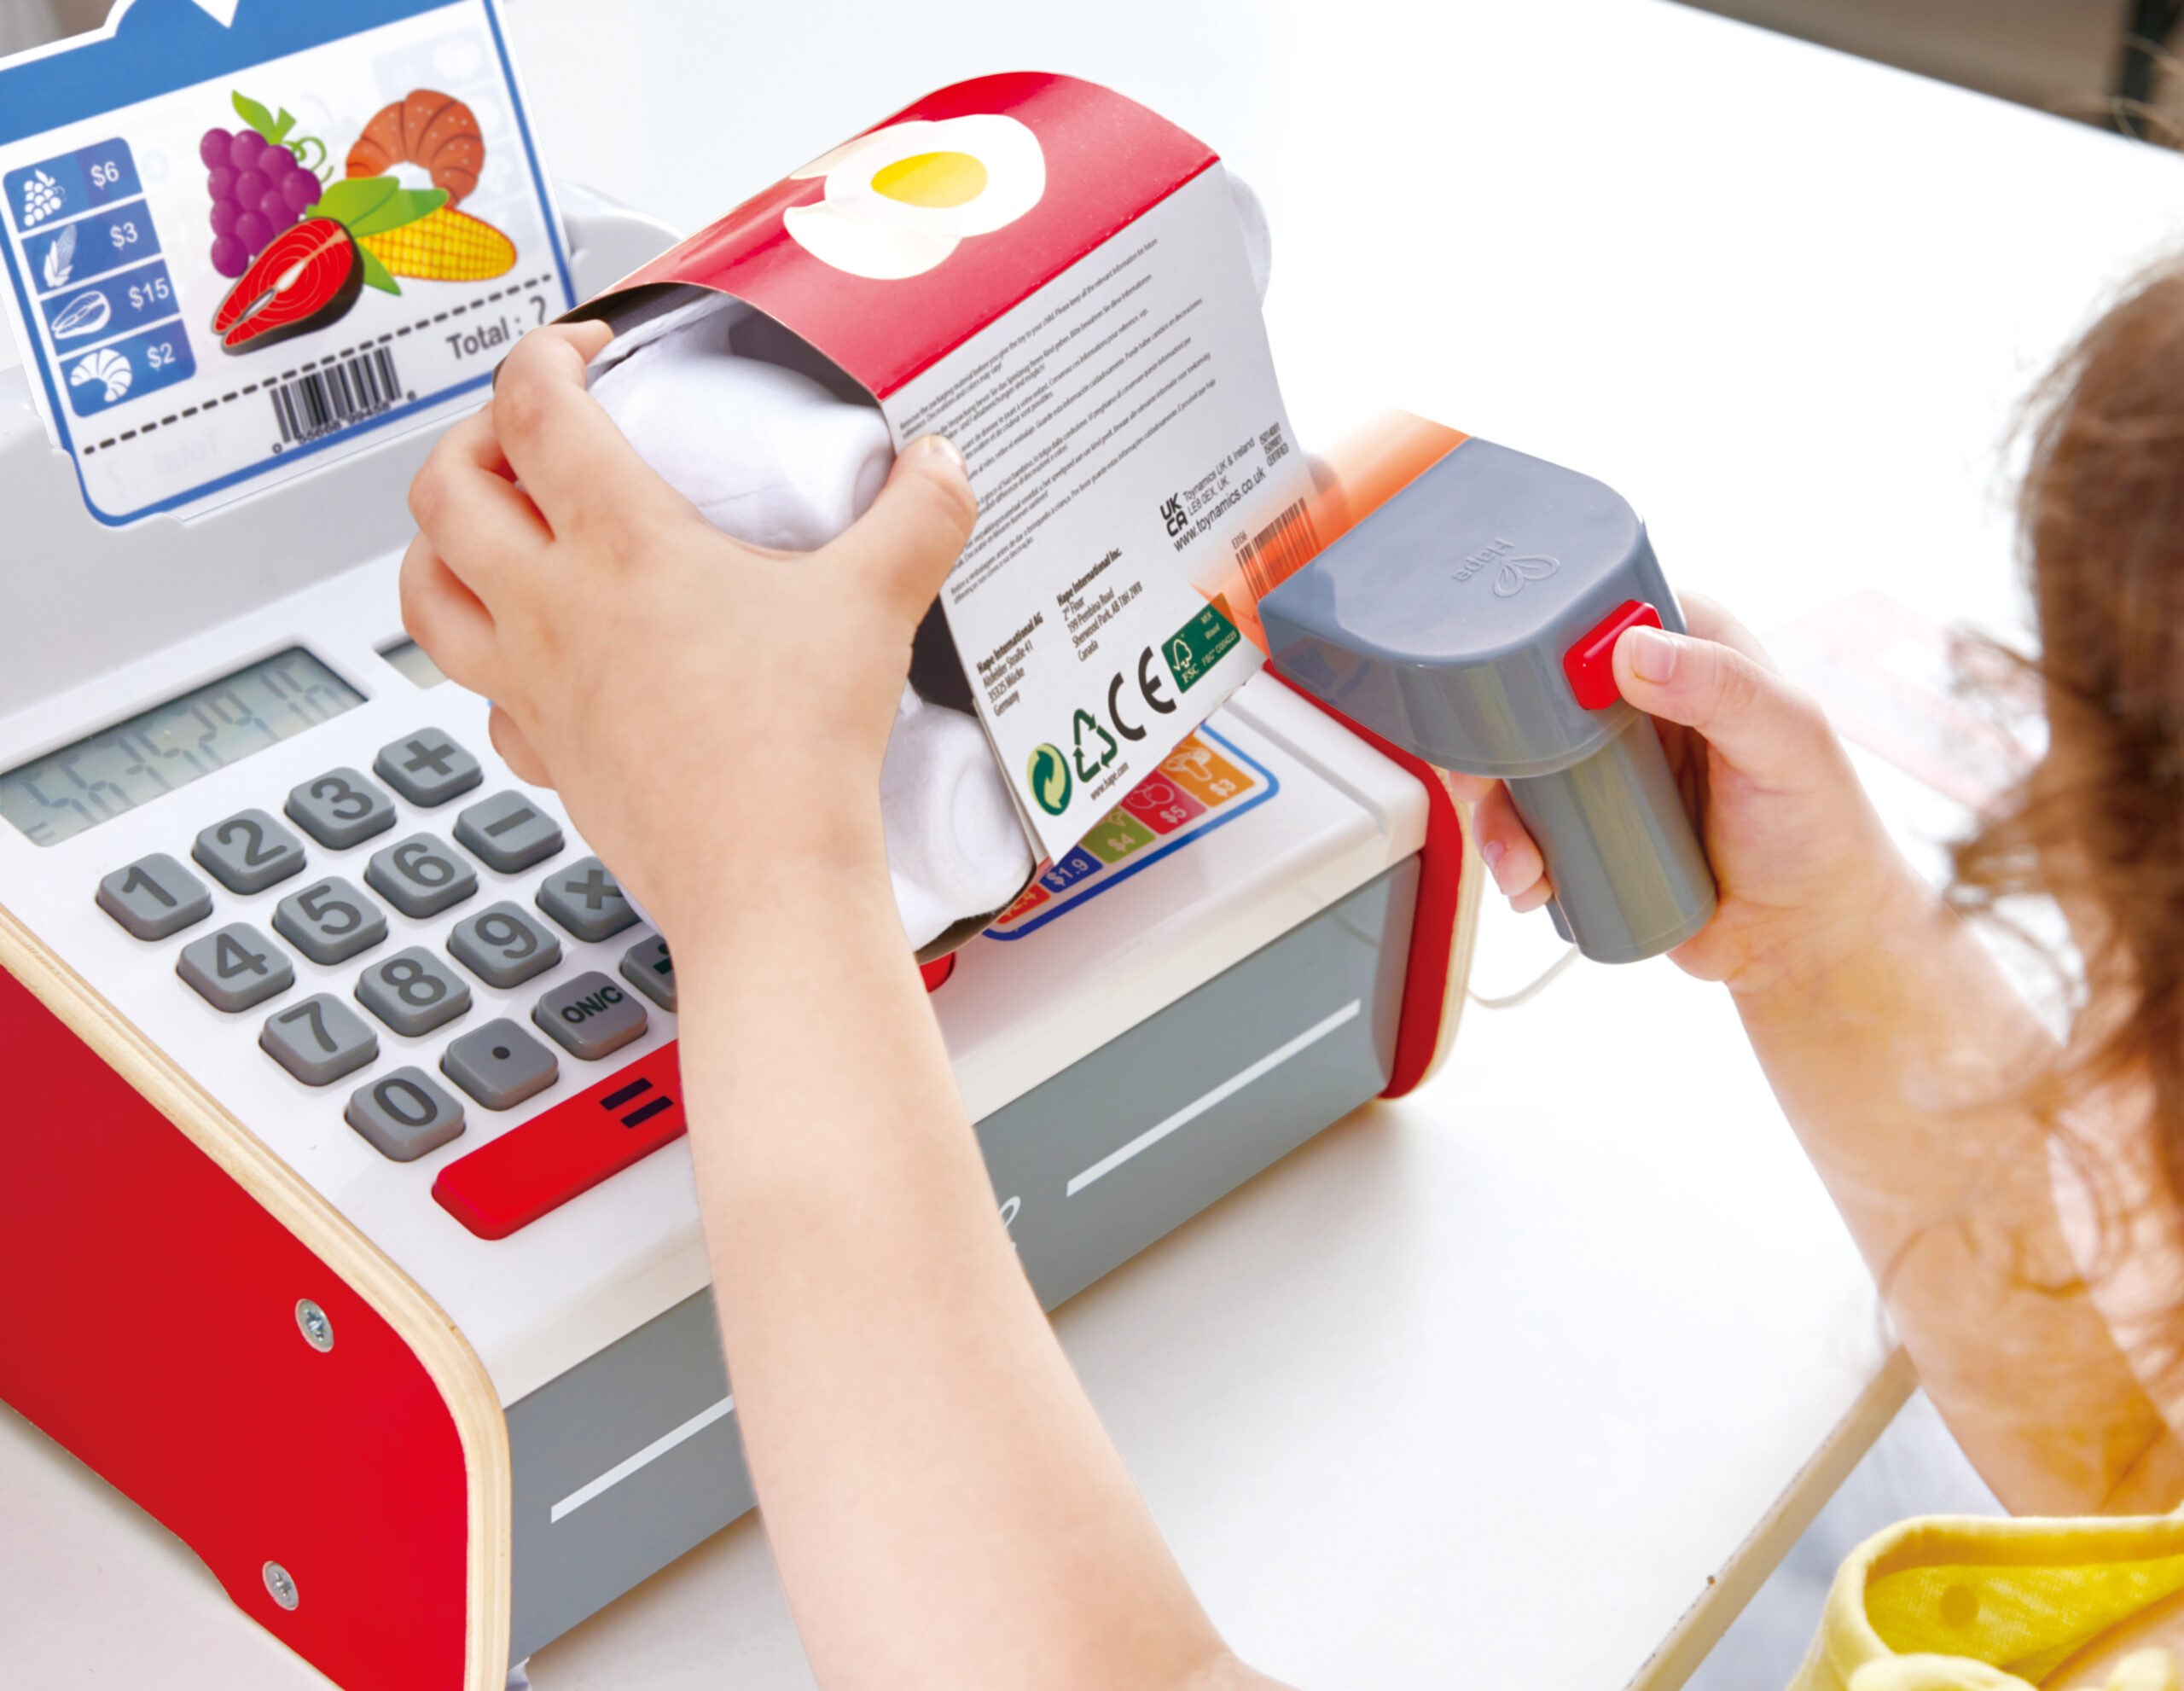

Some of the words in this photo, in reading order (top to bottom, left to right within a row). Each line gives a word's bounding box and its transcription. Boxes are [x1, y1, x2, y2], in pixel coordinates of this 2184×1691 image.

[91, 161, 119, 189] $6
[110, 222, 138, 250] $3
[129, 277, 169, 311] $15
[147, 343, 176, 371] $2
[445, 317, 510, 360] Total
[1182, 470, 1217, 502] Toynamics
[1216, 459, 1228, 475] UK
[1227, 455, 1234, 466] &
[1233, 437, 1255, 461] Ireland
[1160, 492, 1182, 520] UK
[1166, 510, 1188, 537] CA
[1174, 467, 1266, 552] www.toynamics.co.uk
[1452, 537, 1516, 582] Hape
[1056, 588, 1074, 607] Hape
[1072, 554, 1111, 593] International
[1099, 587, 1114, 606] Road
[977, 655, 995, 678] Hape
[993, 619, 1035, 660] International
[1033, 612, 1043, 627] AG
[1072, 619, 1100, 648] Sherwood
[1077, 640, 1099, 661] Canada
[1181, 663, 1199, 684] FSC
[994, 690, 1019, 717] Germany
[311, 777, 373, 820] 3
[1090, 762, 1129, 800] www.hape.com
[1209, 778, 1236, 798] $3
[1160, 805, 1187, 824] $5
[217, 819, 287, 867] 2
[1108, 834, 1136, 852] $4
[392, 843, 456, 887] 6
[1047, 858, 1089, 886] $1.9
[122, 867, 177, 908] 1
[297, 885, 362, 934] 5
[475, 912, 537, 959] 9
[216, 933, 269, 979] 4
[380, 958, 446, 1006] 8
[561, 985, 624, 1025] ON/C
[278, 1001, 338, 1053] 7
[373, 1078, 438, 1127] 0
